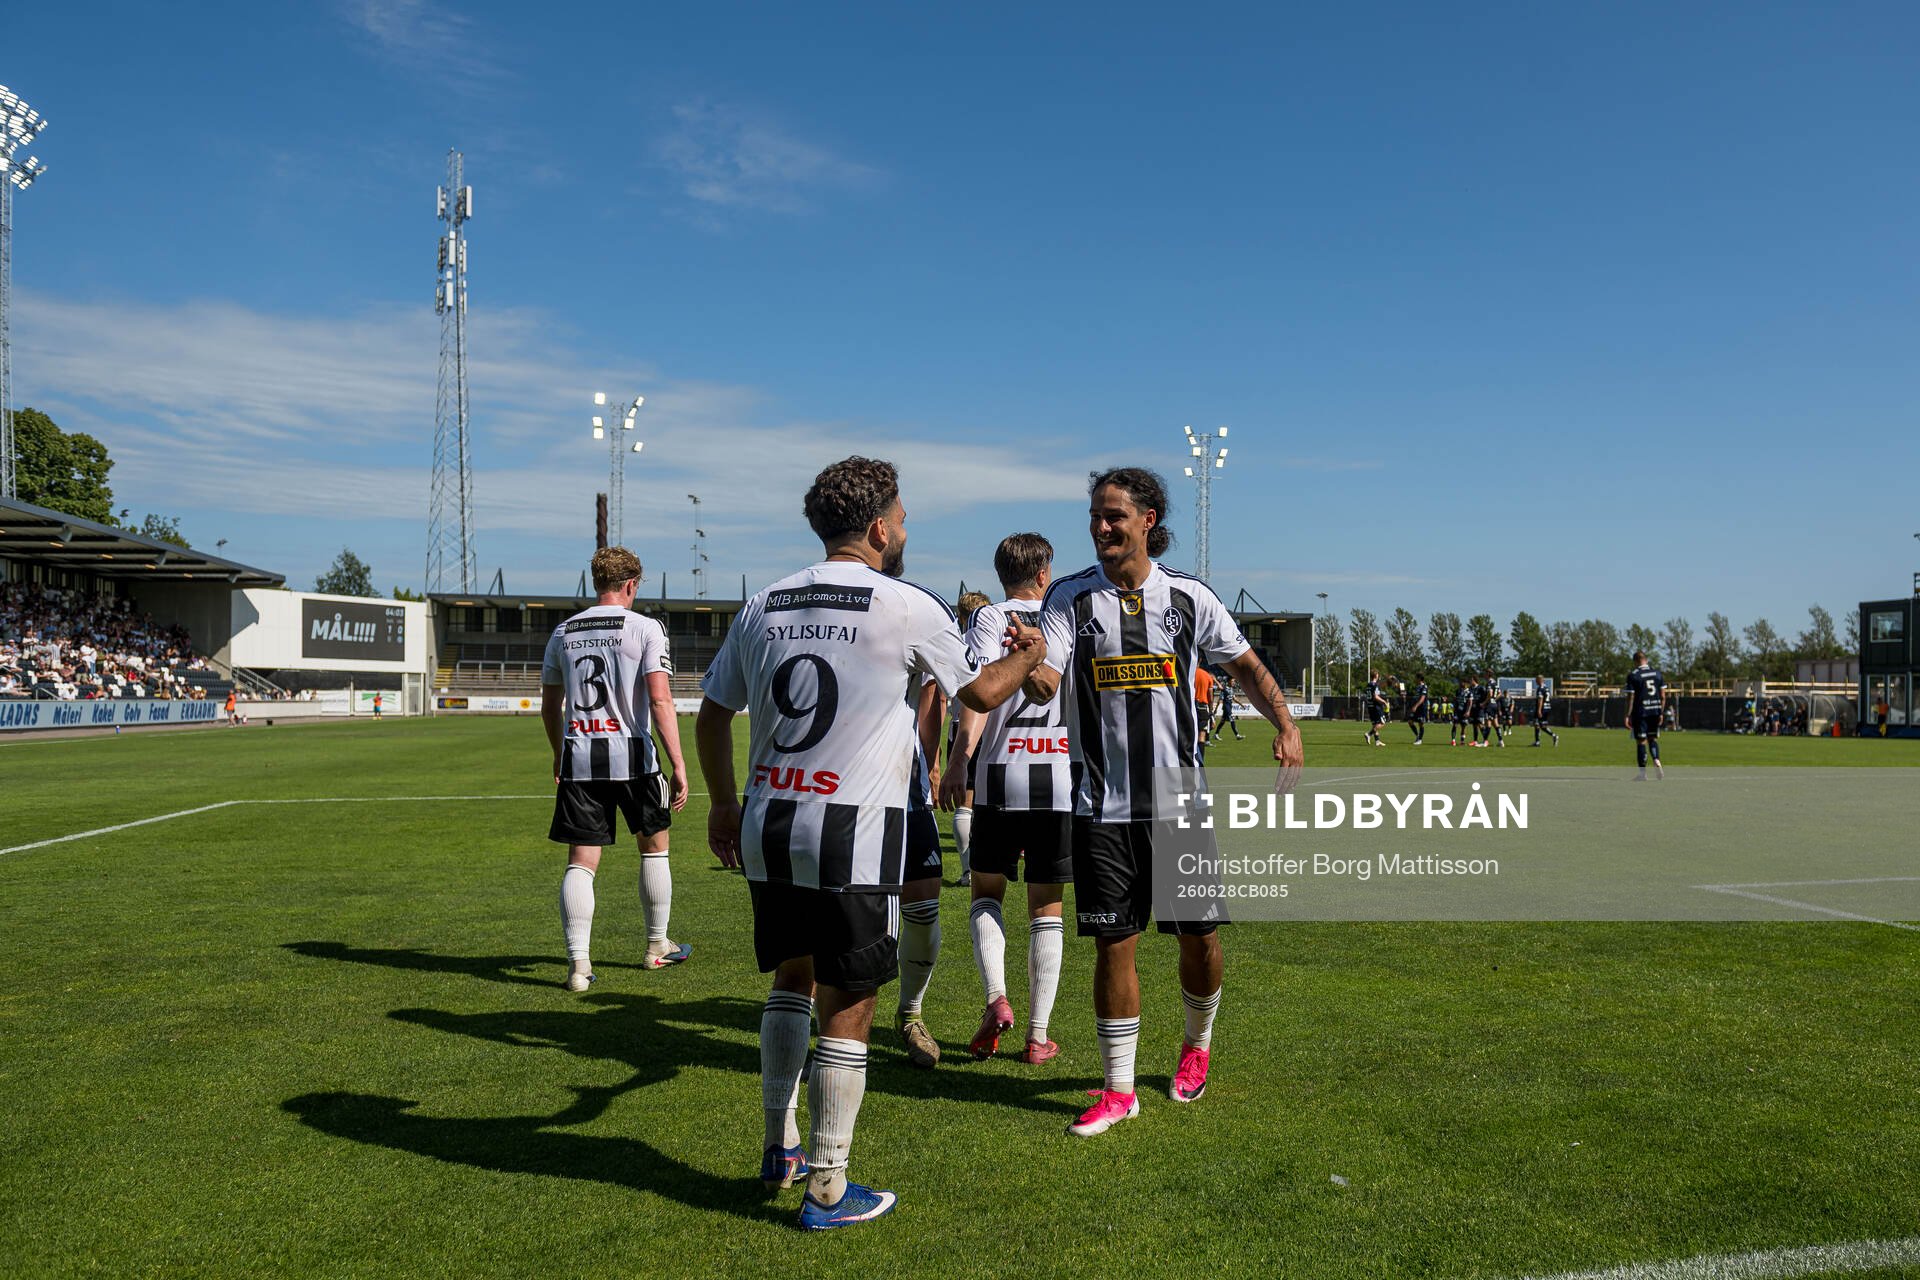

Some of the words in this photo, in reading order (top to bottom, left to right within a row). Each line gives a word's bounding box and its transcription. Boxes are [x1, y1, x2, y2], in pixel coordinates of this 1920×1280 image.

[792, 592, 870, 605] Automotive
[311, 612, 376, 643] MÅL!!!!
[580, 619, 624, 628] Automotive
[766, 624, 858, 644] SYLISUFAJ
[562, 636, 622, 650] WESTSTRÖM
[1098, 664, 1161, 681] OHLSSONS
[574, 654, 609, 712] 3
[1645, 679, 1656, 696] 5
[771, 653, 839, 754] 9
[53, 703, 83, 725] Måleri
[92, 703, 116, 724] Kakel
[124, 703, 141, 722] Golv
[149, 702, 170, 720] Fasad
[568, 718, 622, 734] PULS
[1008, 737, 1069, 754] PULS
[753, 765, 840, 795] PULS
